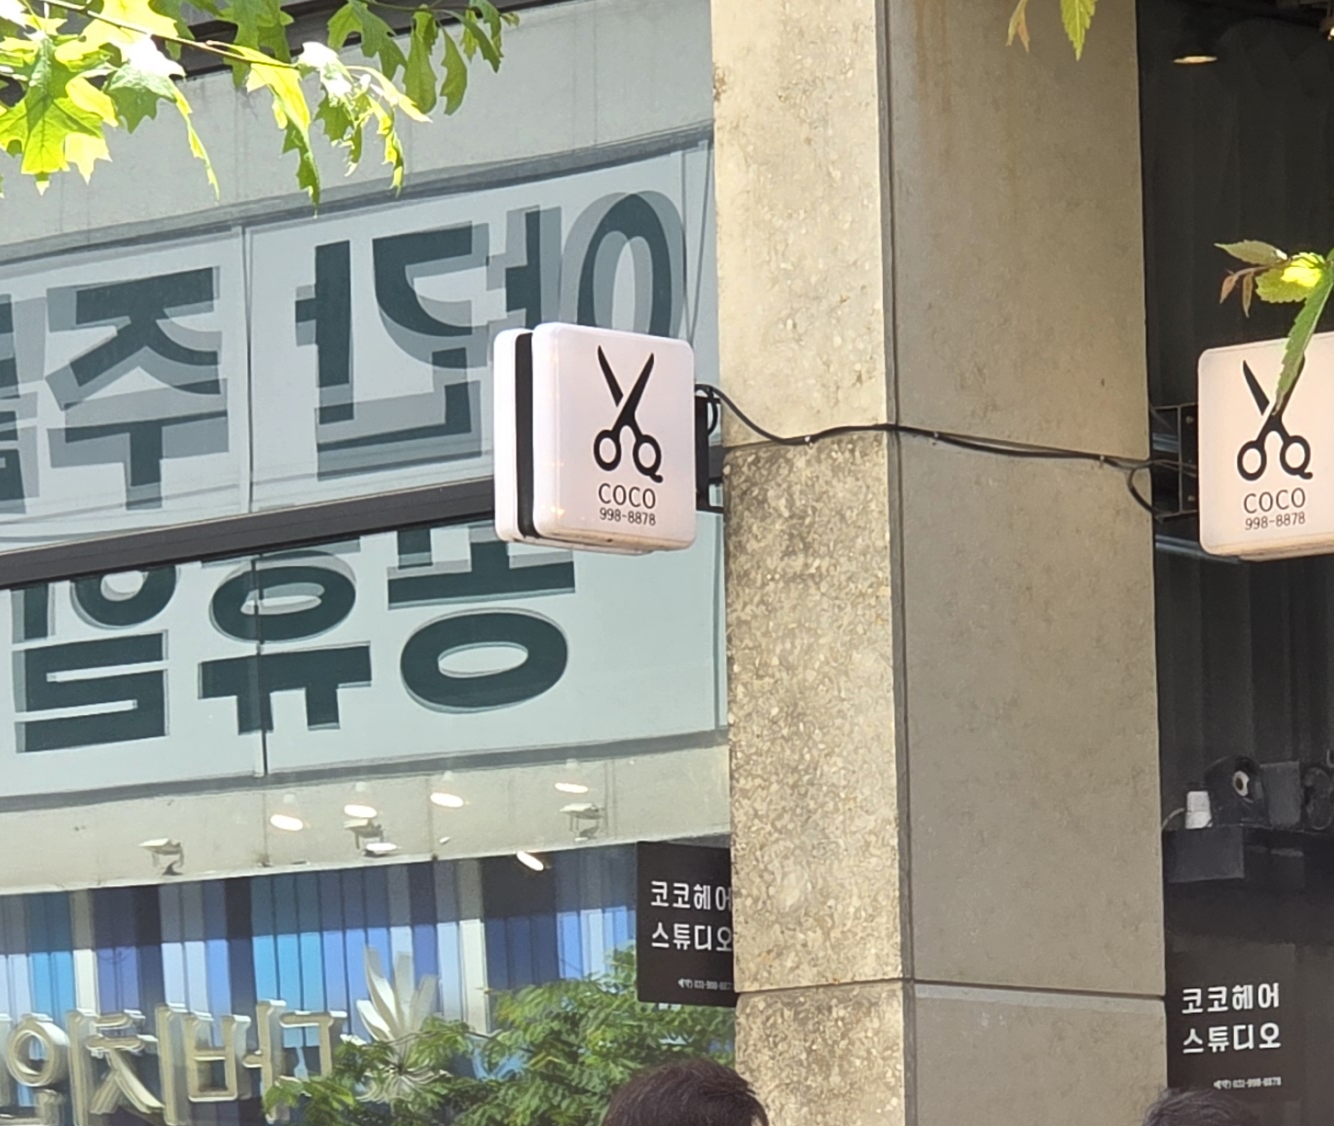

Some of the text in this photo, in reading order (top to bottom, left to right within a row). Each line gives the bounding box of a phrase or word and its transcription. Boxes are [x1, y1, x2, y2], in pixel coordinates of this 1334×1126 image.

[598, 482, 656, 509] COCO
[1243, 487, 1306, 514] COCO
[599, 507, 656, 526] 998-8878
[1244, 511, 1306, 531] 998-8878
[651, 880, 732, 911] 코코헤어
[651, 921, 732, 952] 스튜디오
[1182, 982, 1279, 1014] 코코헤어
[1183, 1022, 1281, 1054] 스튜디오
